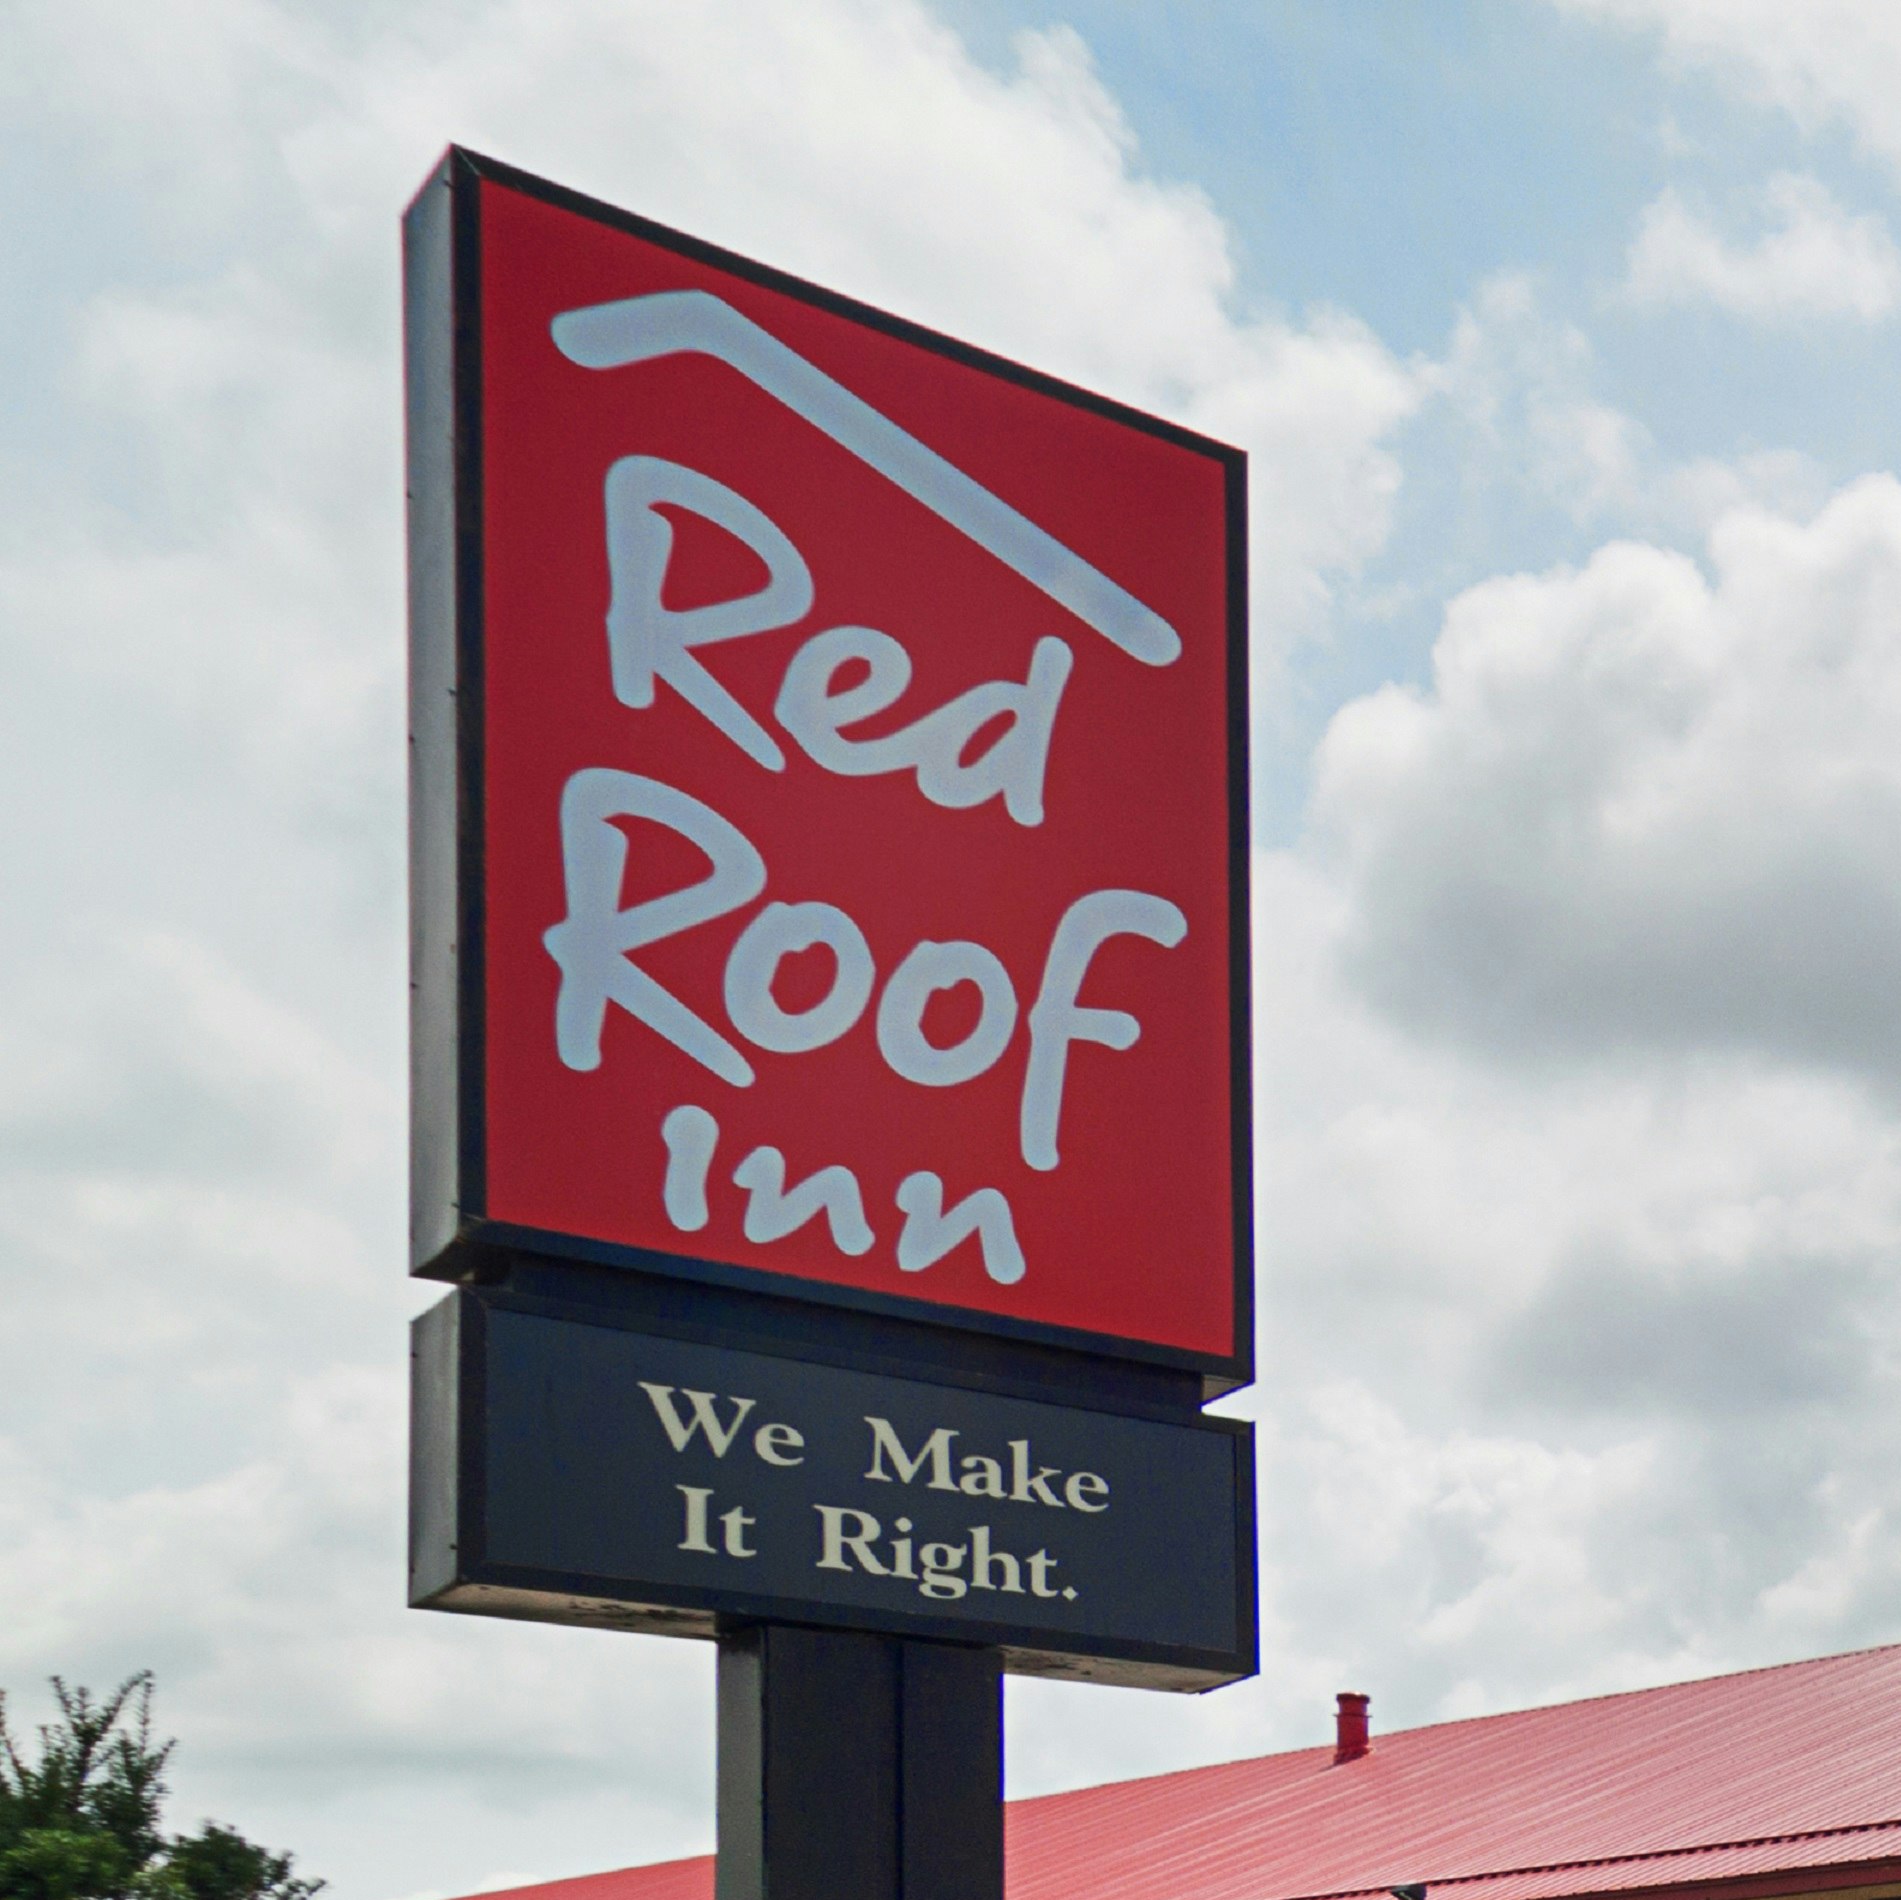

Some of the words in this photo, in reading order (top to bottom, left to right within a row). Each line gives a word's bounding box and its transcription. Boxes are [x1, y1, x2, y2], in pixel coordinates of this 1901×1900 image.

[605, 453, 1072, 827] Red
[543, 767, 1187, 1171] Roof
[660, 1105, 1027, 1285] Inn
[636, 1381, 805, 1466] We
[863, 1416, 1110, 1513] Make
[676, 1483, 757, 1558] It
[813, 1504, 1079, 1600] Right.
